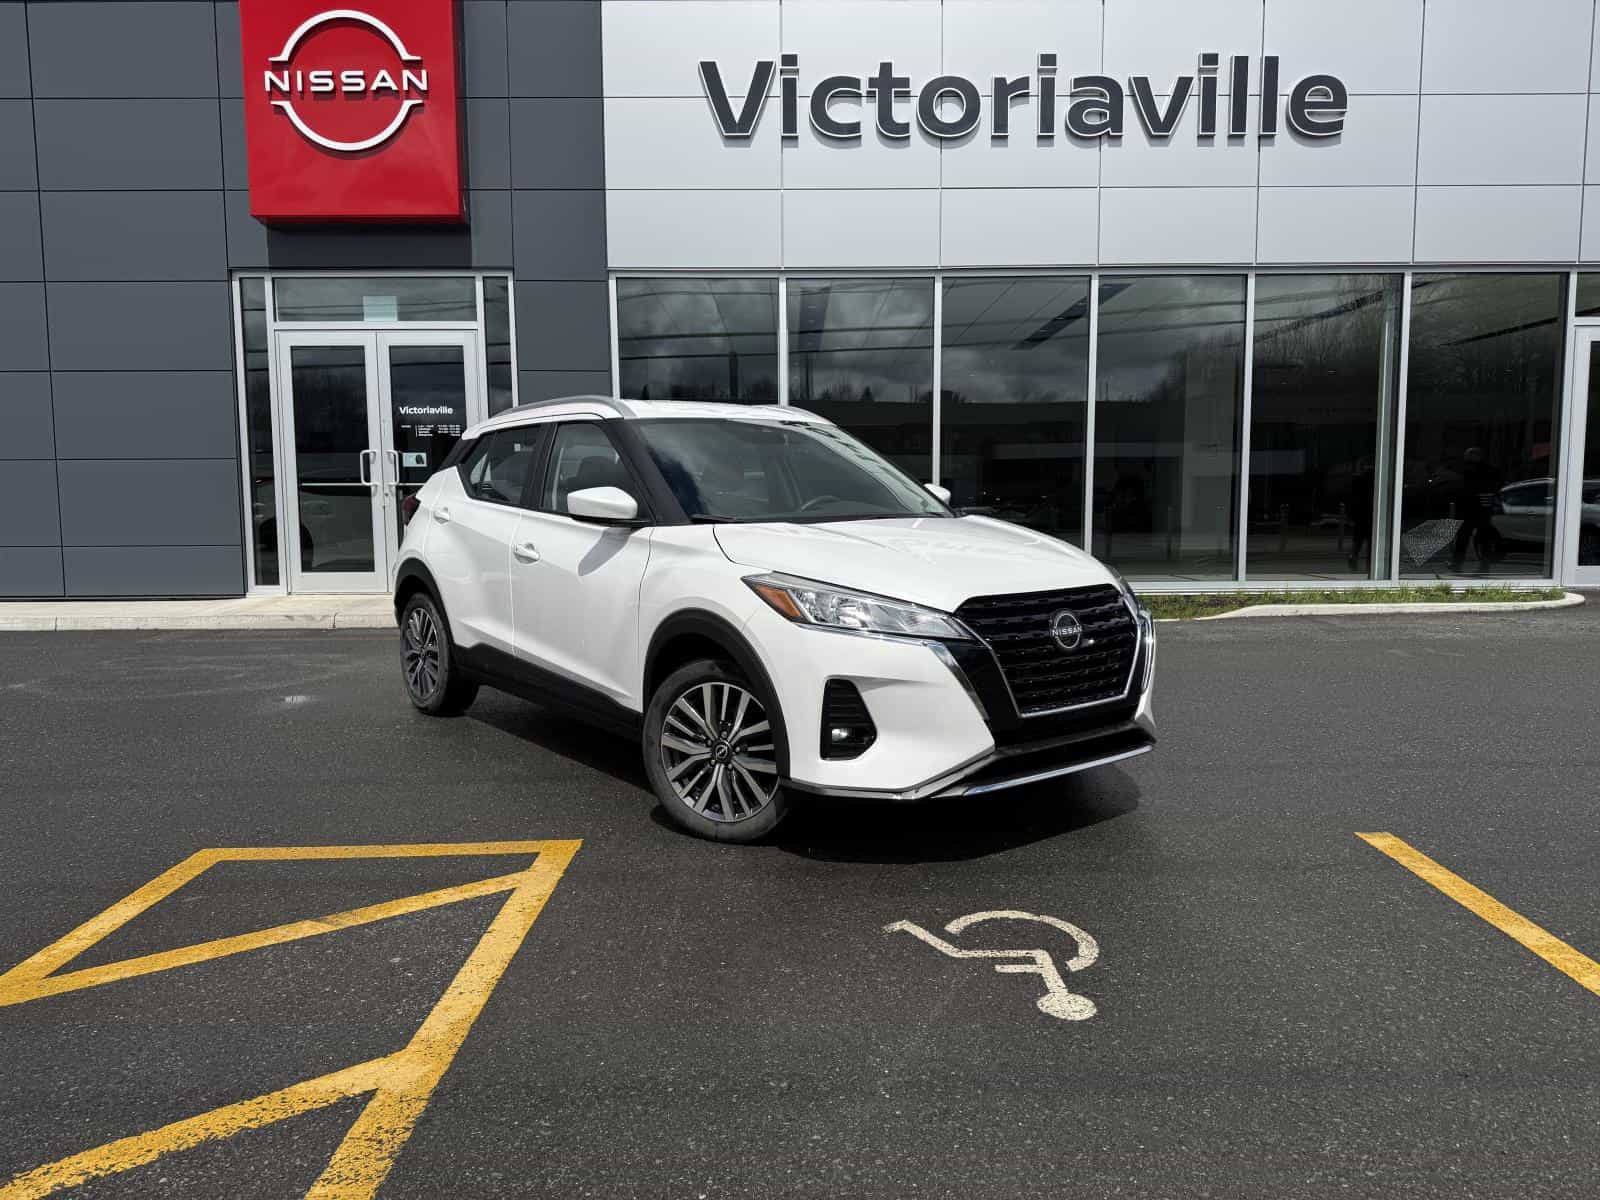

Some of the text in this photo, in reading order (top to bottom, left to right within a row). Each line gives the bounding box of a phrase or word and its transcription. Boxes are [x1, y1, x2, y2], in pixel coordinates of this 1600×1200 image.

[264, 69, 428, 92] NISSAN
[698, 53, 1349, 141] Victoriaville
[399, 405, 454, 414] Victoriaville
[1052, 625, 1082, 636] NISSAN
